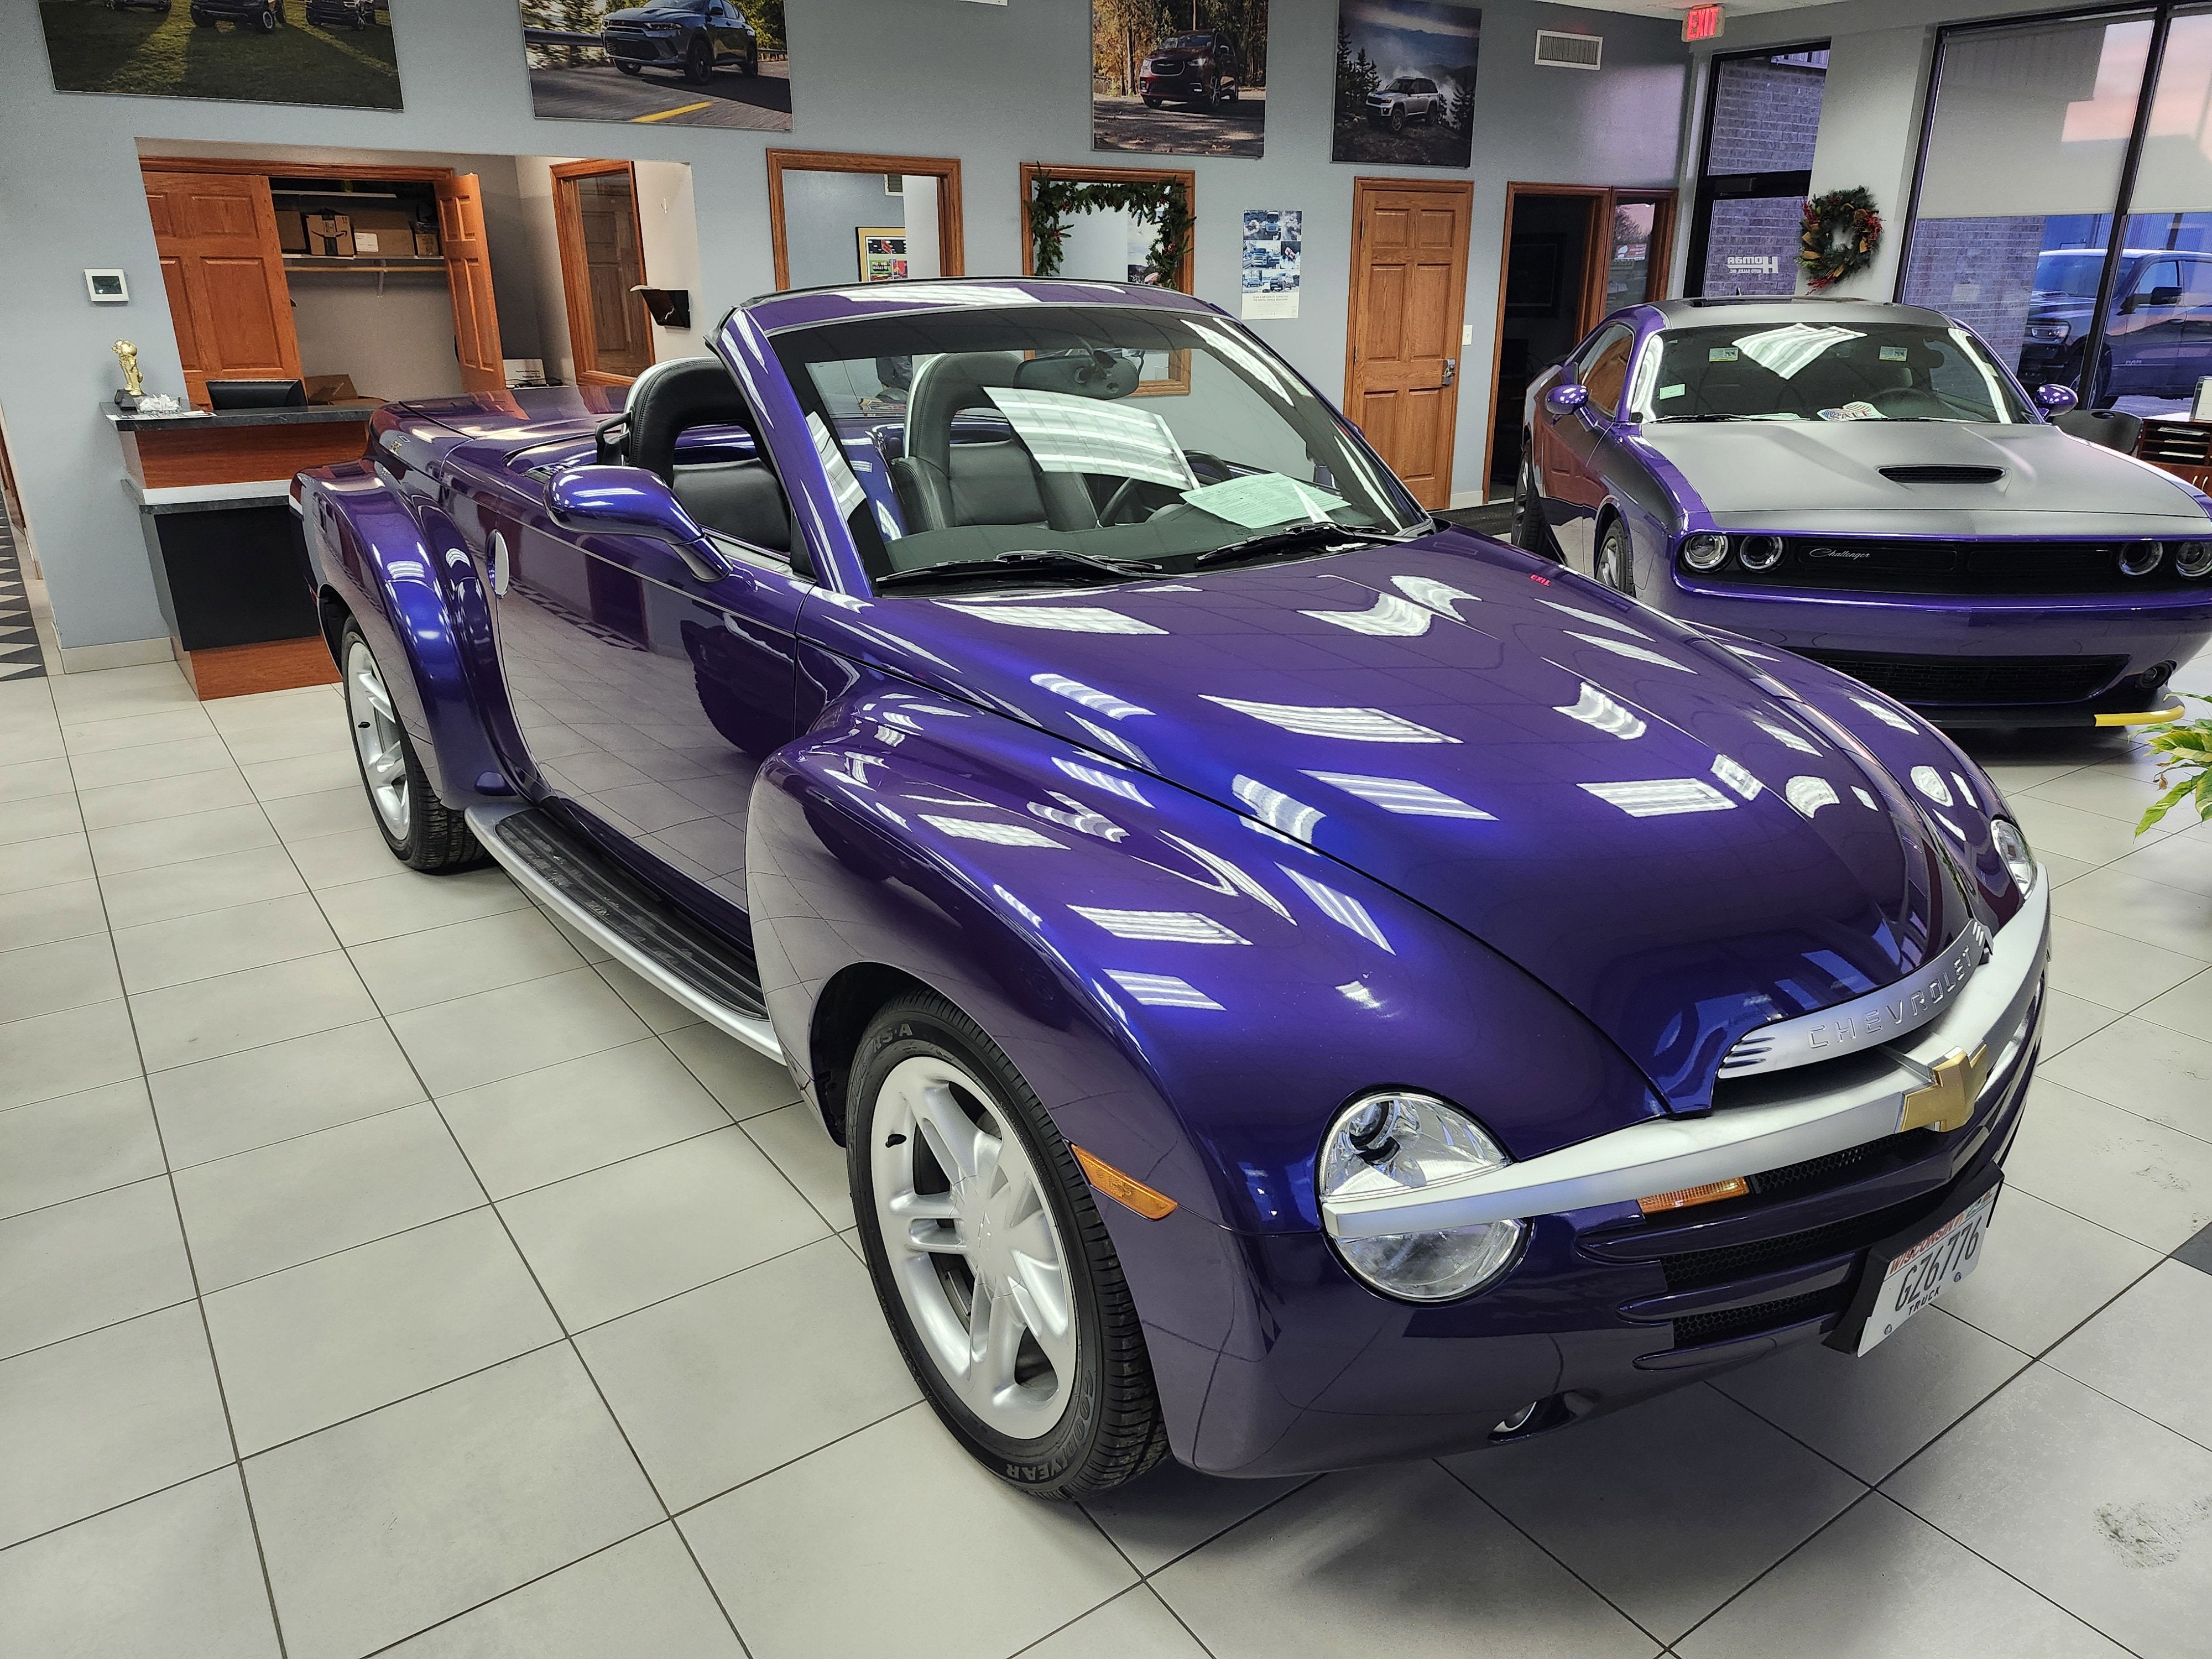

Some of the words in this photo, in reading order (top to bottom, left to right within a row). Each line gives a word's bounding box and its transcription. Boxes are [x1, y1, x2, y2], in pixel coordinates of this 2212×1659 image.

[1687, 7, 1719, 40] EXIT
[1809, 548, 1870, 560] Challenger
[1808, 945, 1973, 1049] CHEVROLET
[1895, 1215, 1982, 1312] GZ6776
[1908, 1285, 1941, 1316] TRUCK
[1005, 1369, 1094, 1481] GOODYEAR
